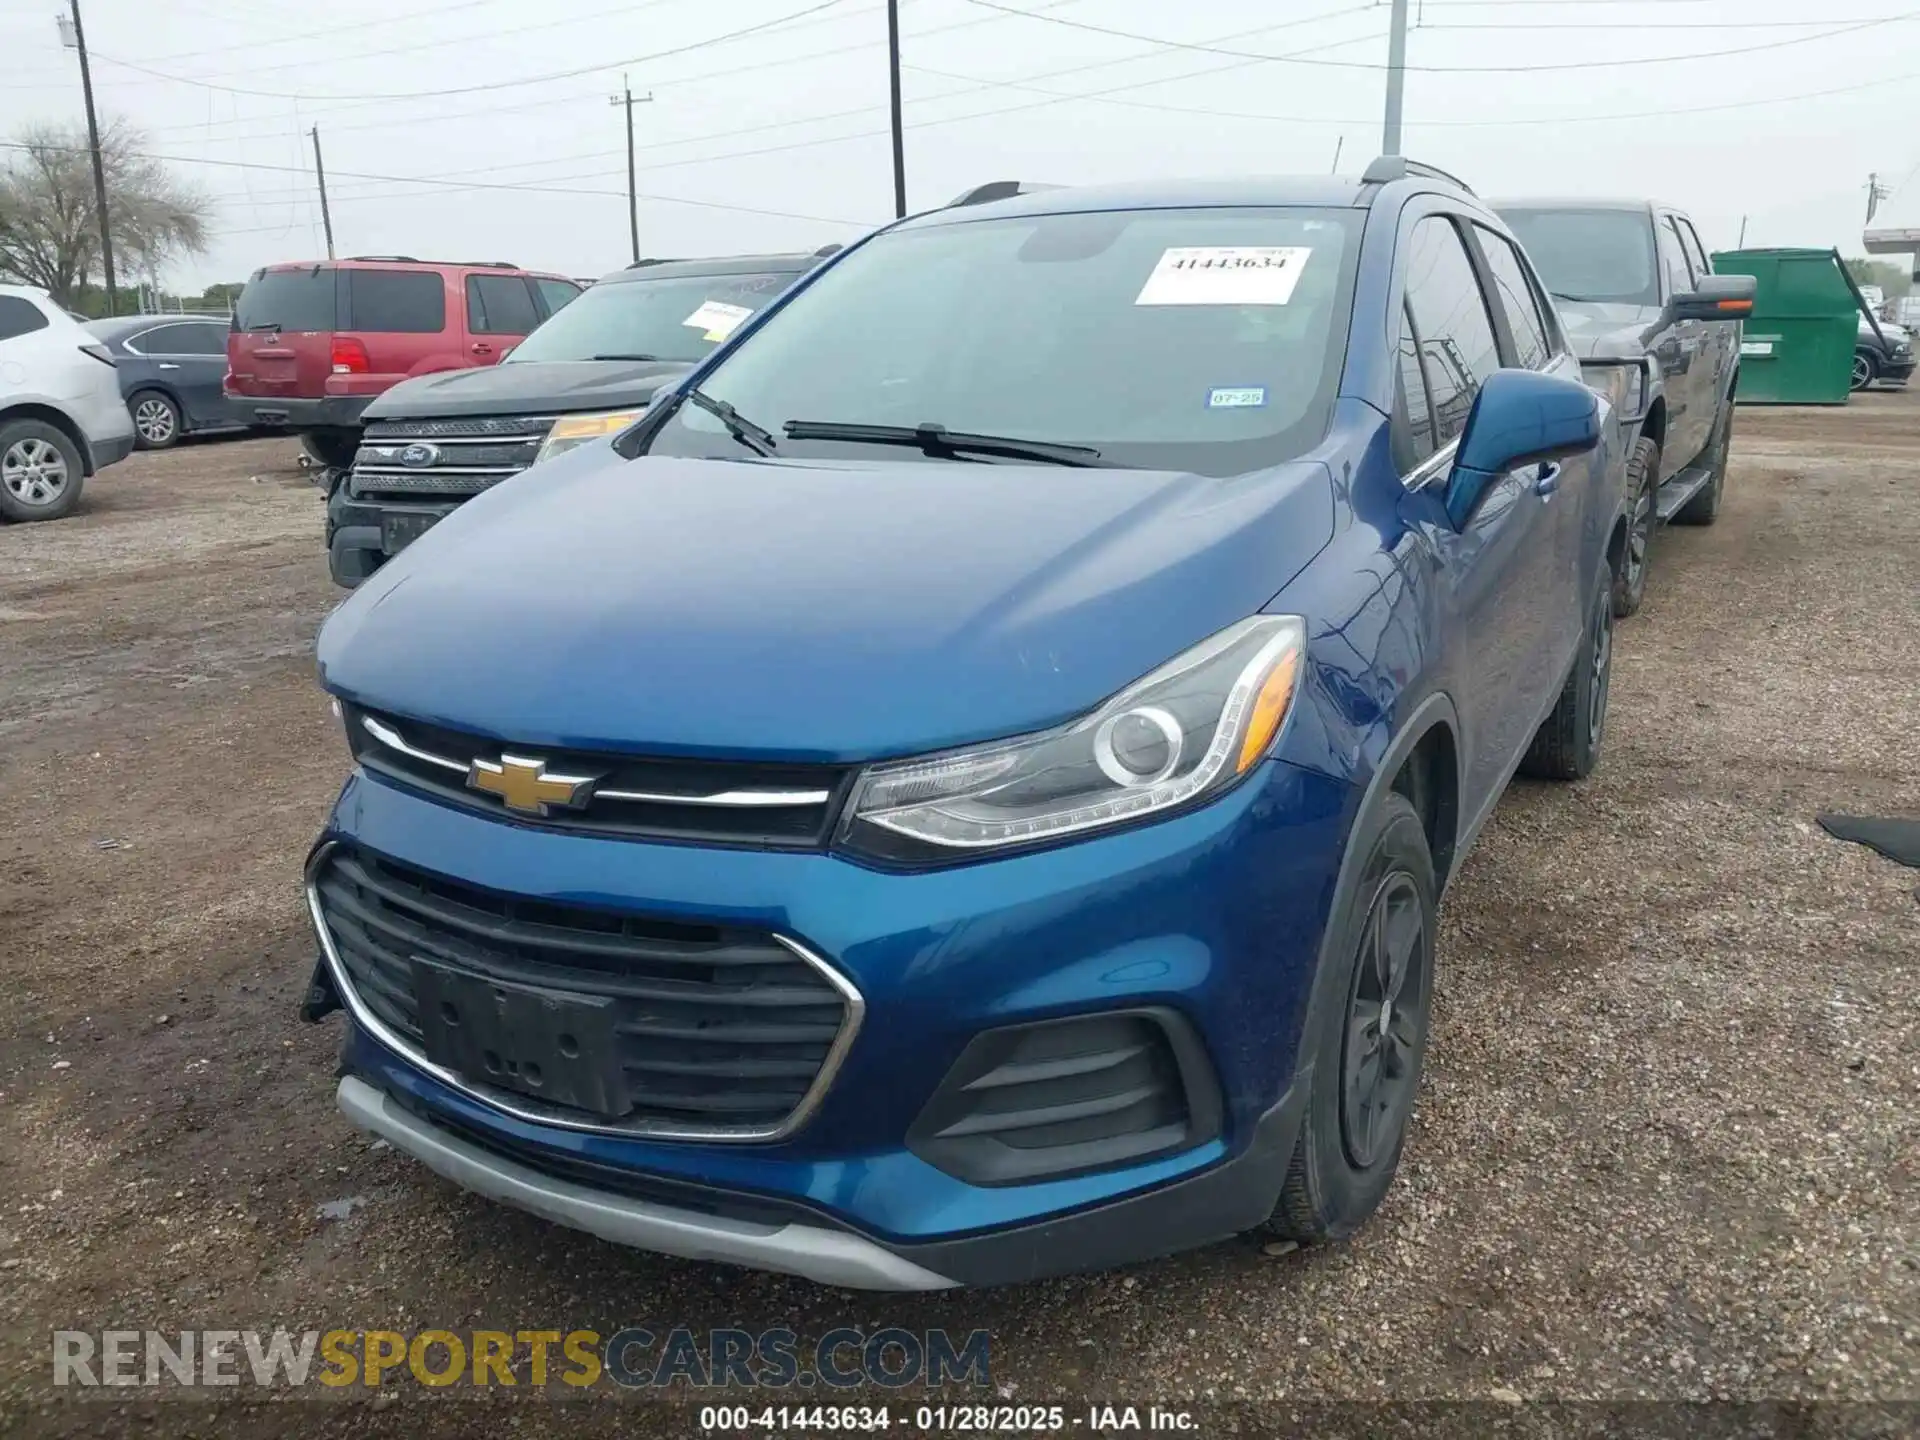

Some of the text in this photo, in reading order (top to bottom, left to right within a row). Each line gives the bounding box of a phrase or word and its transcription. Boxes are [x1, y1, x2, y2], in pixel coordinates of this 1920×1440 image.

[1171, 257, 1287, 270] 41443634
[1213, 394, 1261, 405] 07-25
[403, 448, 426, 461] Ford
